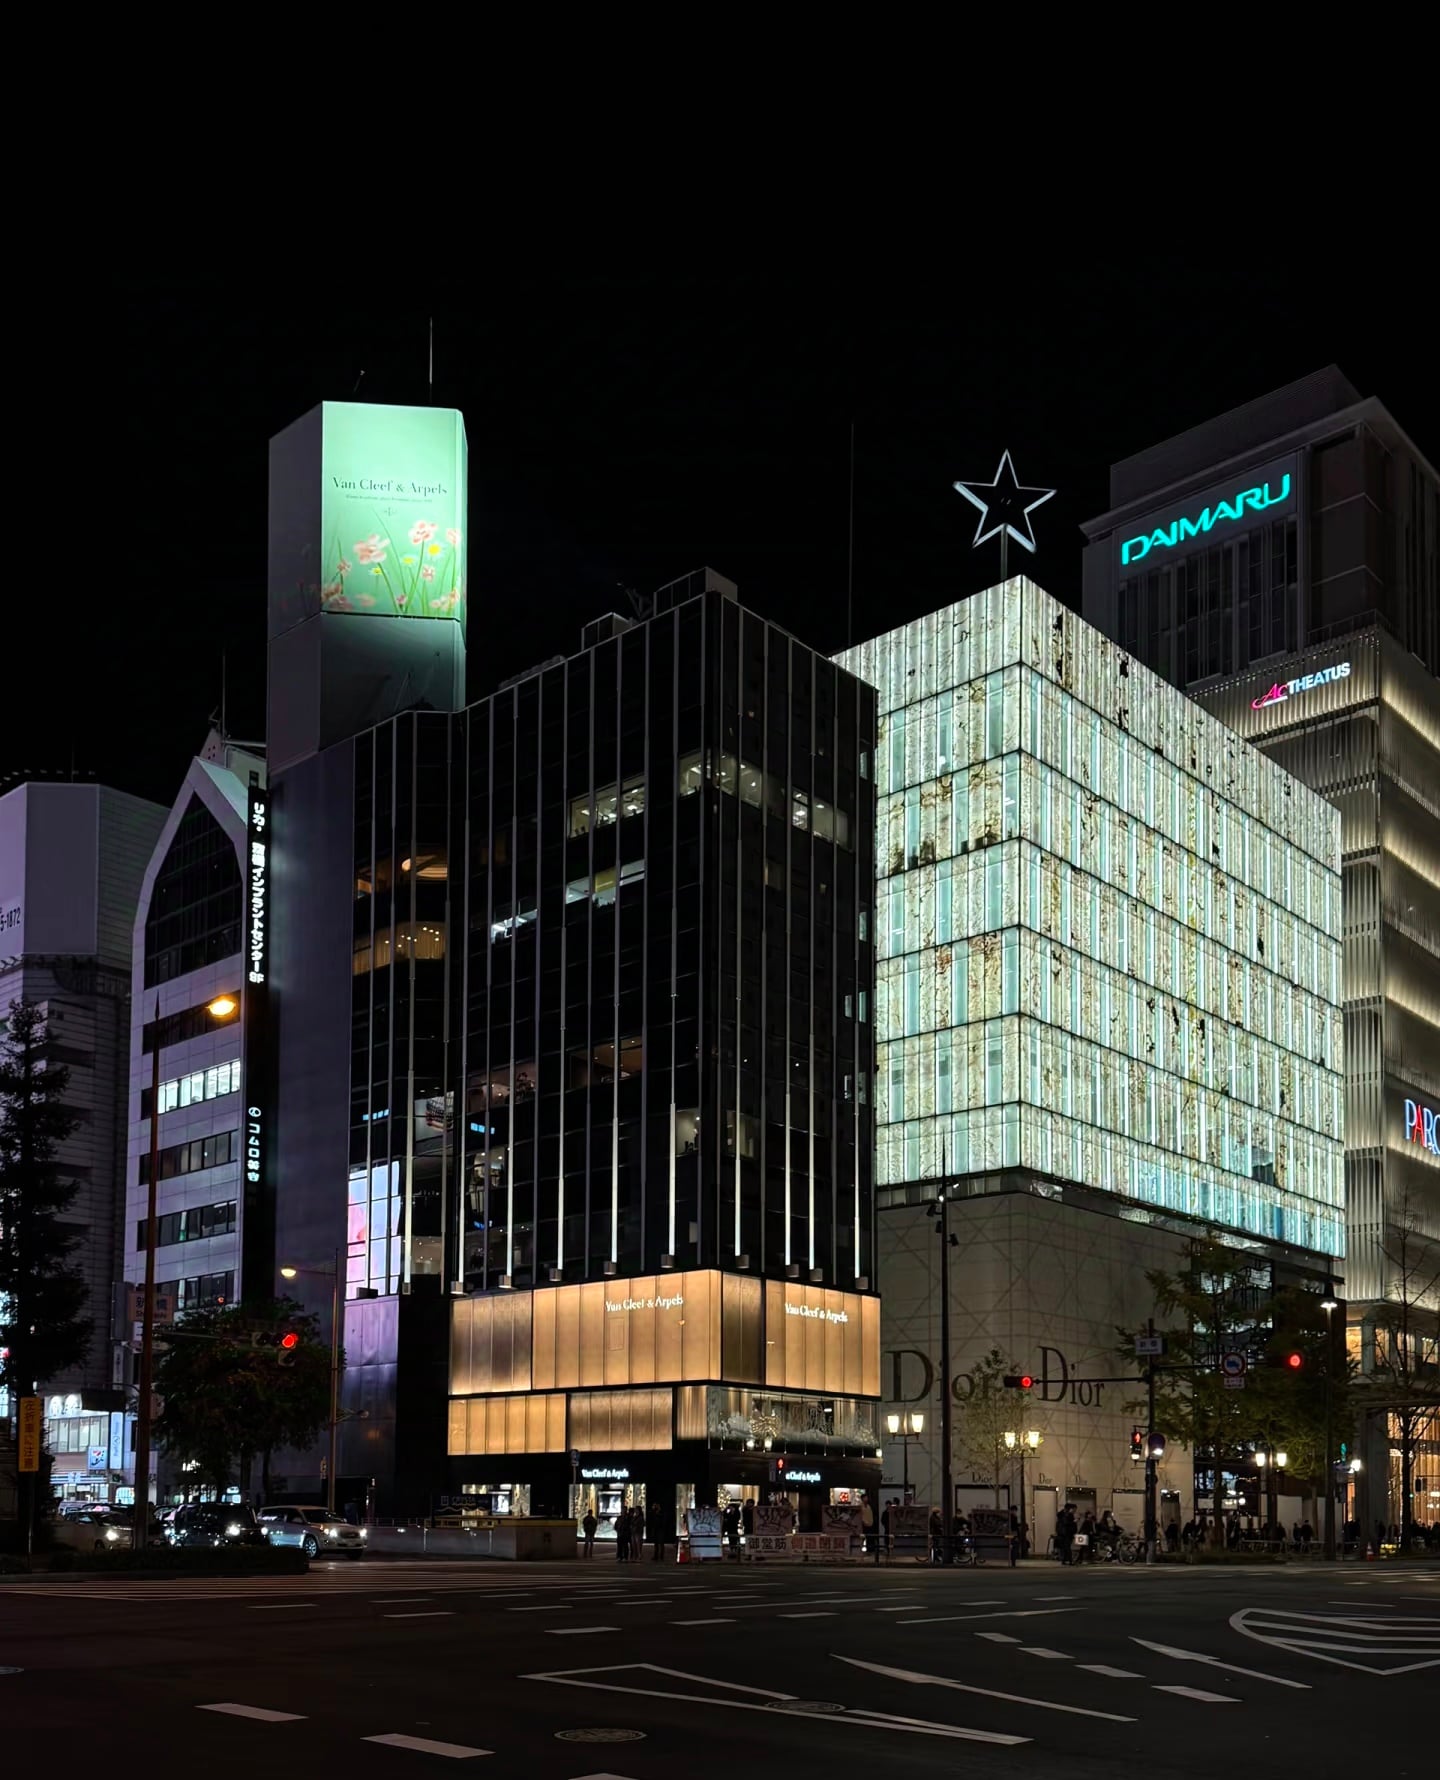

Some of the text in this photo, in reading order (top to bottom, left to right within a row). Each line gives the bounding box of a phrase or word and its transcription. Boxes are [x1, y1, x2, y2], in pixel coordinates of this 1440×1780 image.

[333, 477, 448, 497] Van Cleef & Arpels
[1121, 473, 1291, 564] DAIMARU
[246, 1122, 261, 1183] コムロ
[605, 1293, 684, 1312] Van Cleef & Arpels
[784, 1302, 799, 1315] Van
[799, 1305, 819, 1318] Cleef
[826, 1308, 848, 1324] Arpels
[1036, 1346, 1105, 1407] Dior
